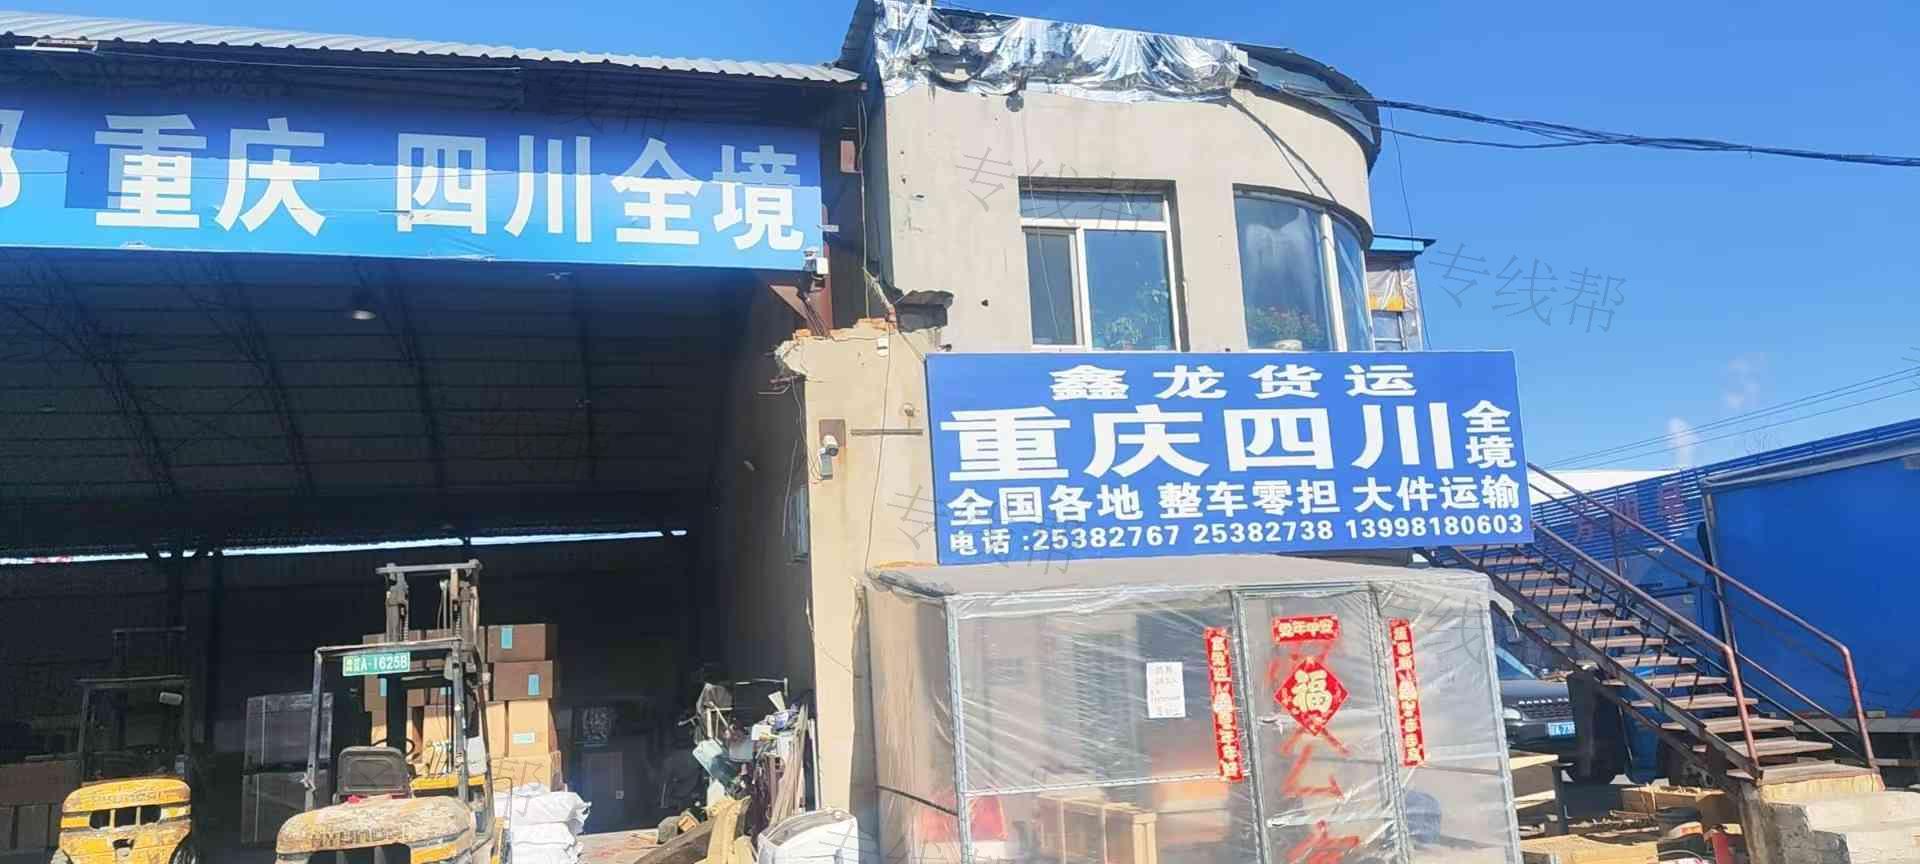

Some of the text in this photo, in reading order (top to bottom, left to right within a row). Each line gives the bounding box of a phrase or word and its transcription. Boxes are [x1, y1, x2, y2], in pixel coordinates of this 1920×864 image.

[94, 113, 327, 237] 重庆
[394, 132, 805, 251] 四川全境
[1049, 364, 1417, 401] 鑫龙货运
[940, 402, 1454, 482] 重庆四川
[1462, 400, 1517, 469] 全境
[948, 474, 1520, 526] 全国各地 整车零担 大件运输
[1193, 519, 1334, 545] 25382738
[1345, 514, 1523, 540] 13998180603
[1291, 669, 1333, 714] 福
